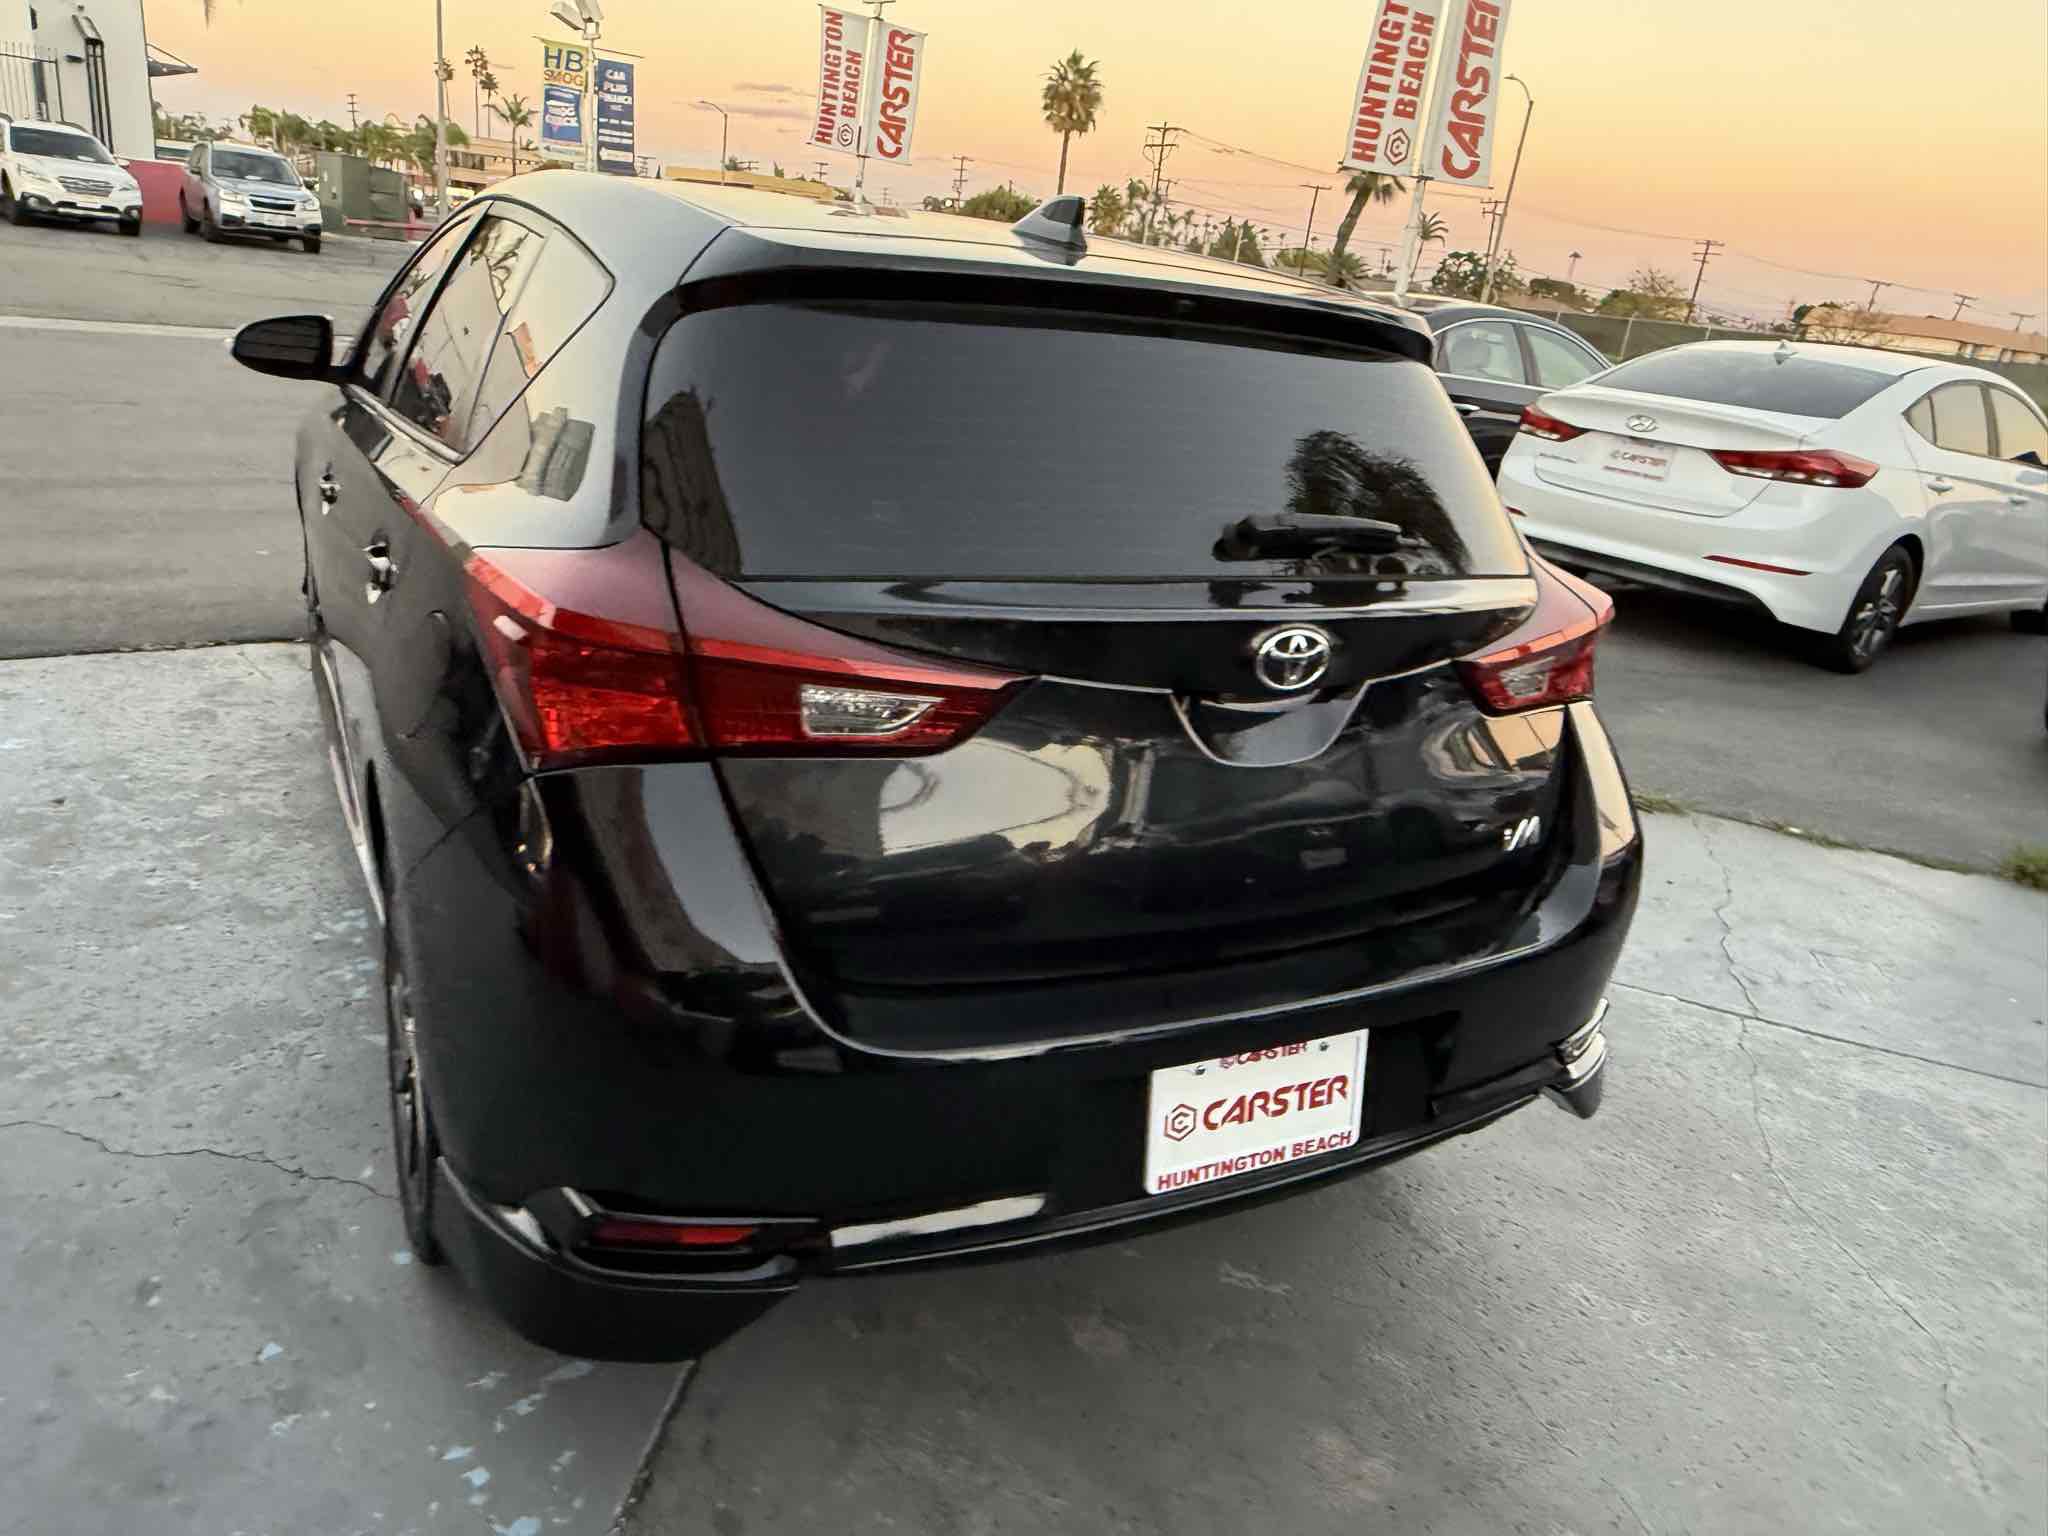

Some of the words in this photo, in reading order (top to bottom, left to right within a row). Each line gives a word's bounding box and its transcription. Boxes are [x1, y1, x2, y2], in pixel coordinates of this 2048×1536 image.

[544, 46, 584, 72] HB
[544, 69, 585, 87] SMOG
[815, 11, 843, 145] HUNTINGTON
[841, 50, 862, 118] BEACH
[1393, 11, 1435, 120] BEACH
[876, 29, 916, 158] CARSTER
[1203, 1074, 1350, 1131] CARSTER
[1157, 1146, 1287, 1191] HUNTINGTON
[1291, 1131, 1352, 1158] BEACH
